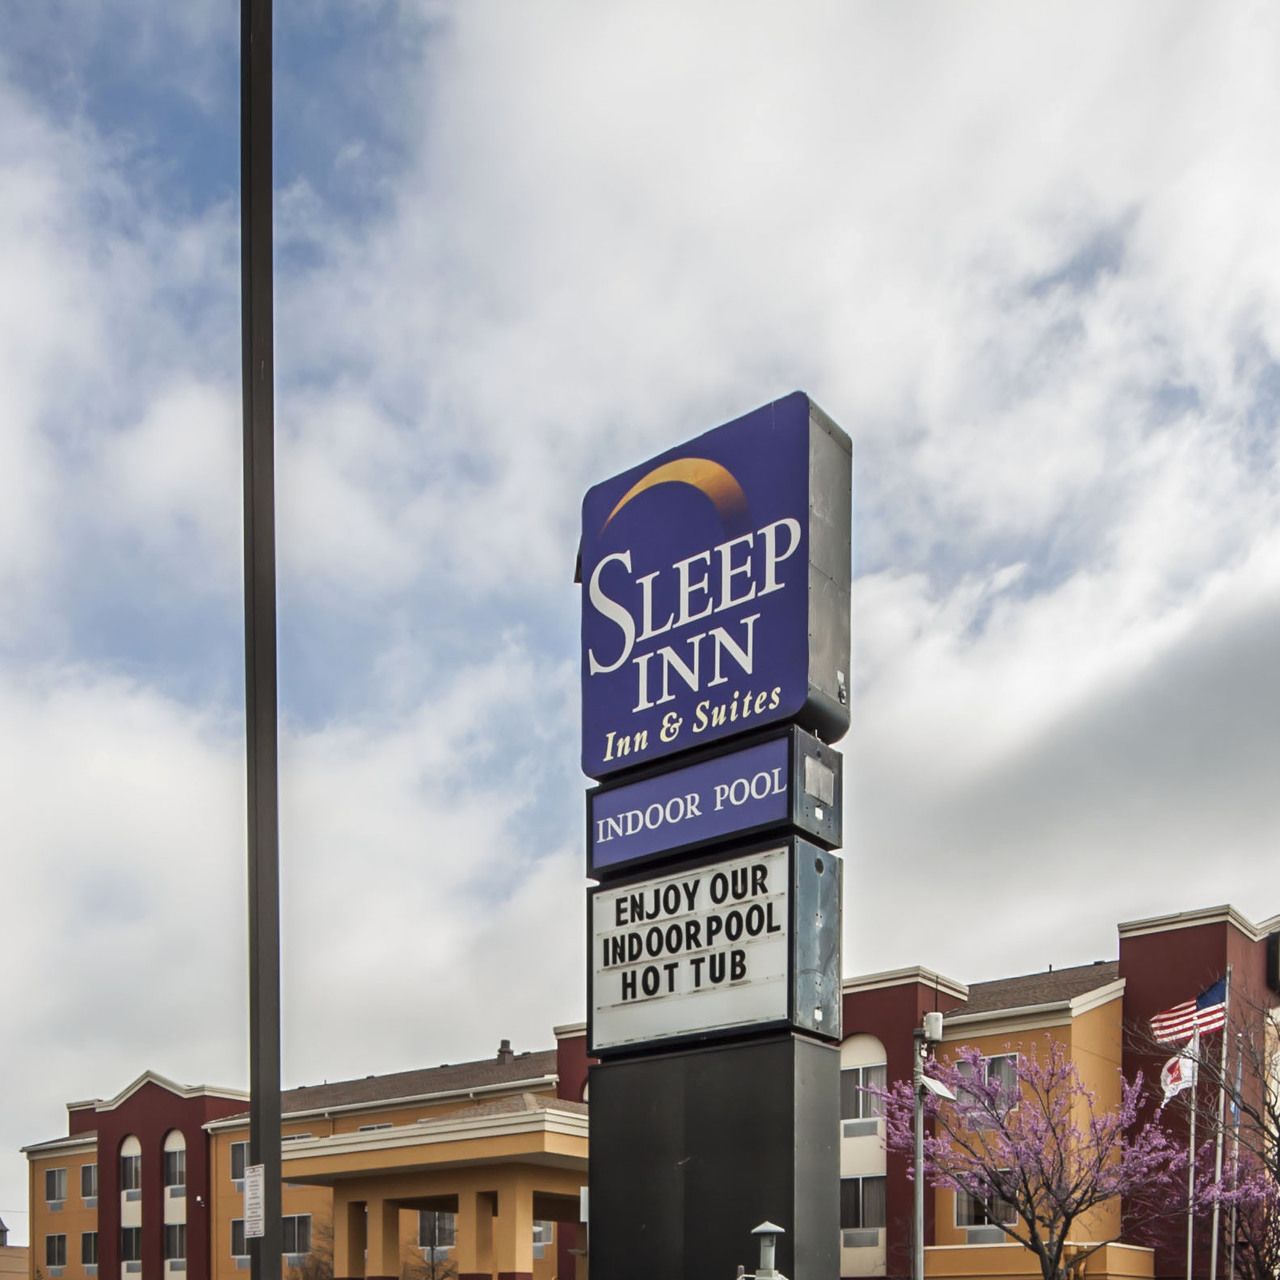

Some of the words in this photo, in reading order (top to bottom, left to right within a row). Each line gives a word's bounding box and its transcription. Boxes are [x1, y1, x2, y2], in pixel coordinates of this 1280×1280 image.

[589, 517, 801, 677] SLEEP
[632, 613, 761, 713] INN
[603, 731, 649, 762] Inn
[660, 711, 683, 742] &
[692, 685, 782, 734] Suites
[596, 793, 702, 844] INDOOR
[714, 768, 787, 812] POOL
[615, 879, 700, 927] ENJOY
[710, 864, 768, 902] OUR
[622, 962, 679, 1001] HOT
[690, 949, 747, 988] TUB
